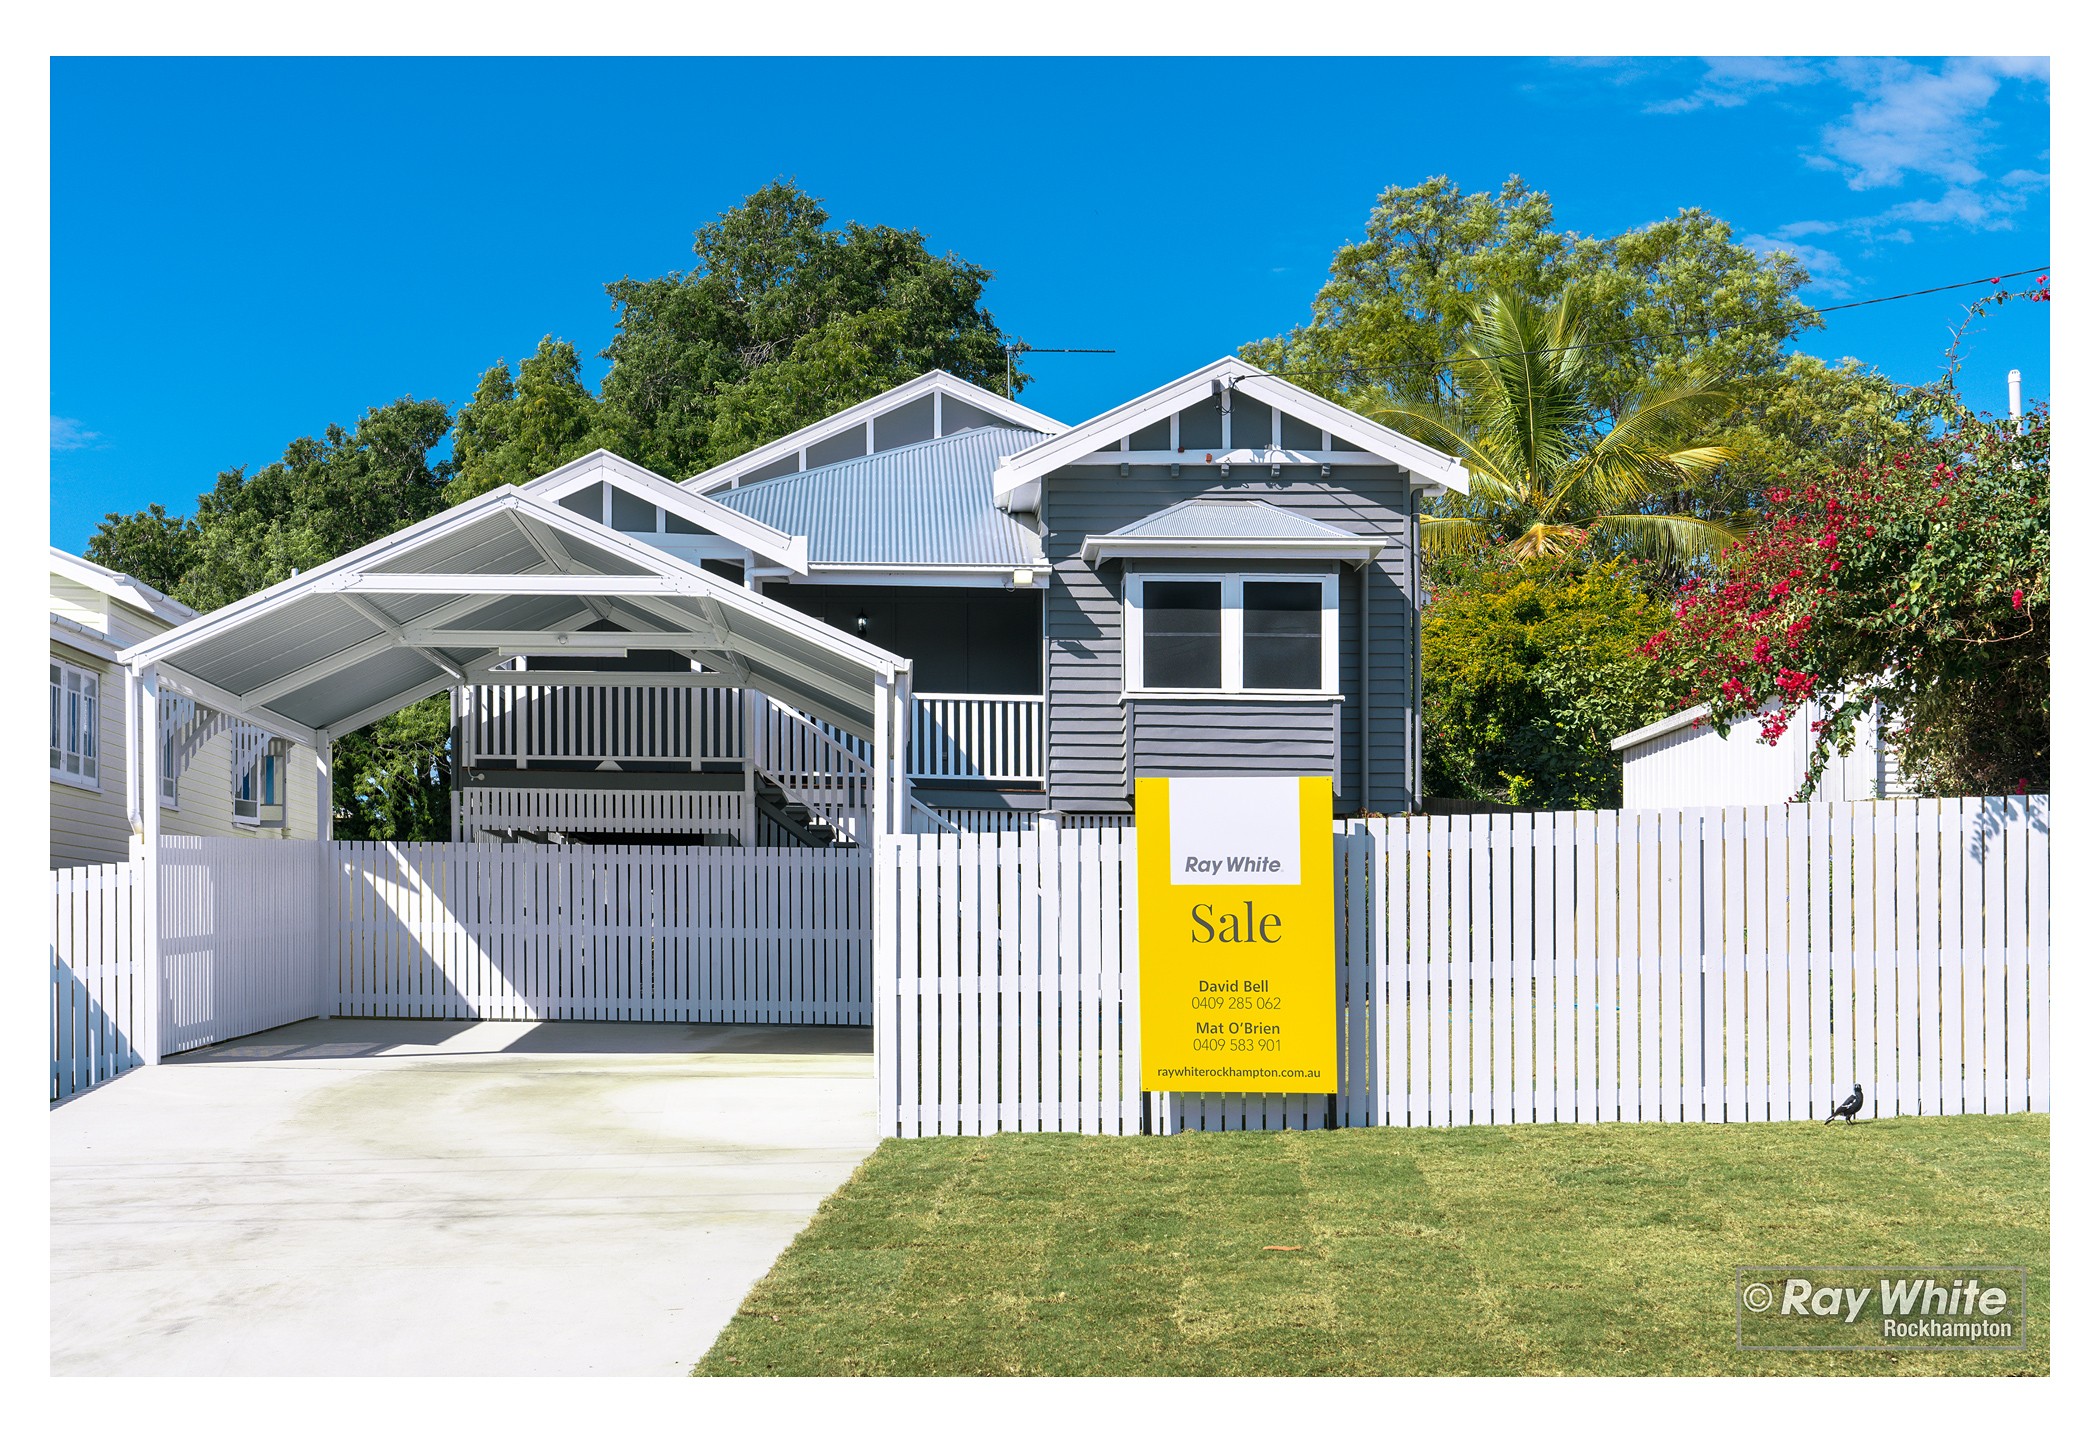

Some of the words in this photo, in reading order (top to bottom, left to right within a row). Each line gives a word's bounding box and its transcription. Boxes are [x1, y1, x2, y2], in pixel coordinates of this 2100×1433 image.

[1184, 857, 1224, 875] Ray
[1226, 857, 1281, 872] White
[1191, 901, 1282, 943] Sale
[1199, 980, 1239, 992] David
[1243, 980, 1269, 992] Bell
[1191, 997, 1225, 1009] 0409
[1228, 997, 1253, 1009] 285
[1256, 997, 1281, 1009] 062
[1196, 1022, 1225, 1034] Mat
[1228, 1022, 1281, 1034] O'Brien
[1192, 1039, 1226, 1051] 0409
[1230, 1039, 1255, 1051] 583
[1257, 1039, 1281, 1051] 901
[1157, 1067, 1321, 1079] raywhiterockhampton.com.au
